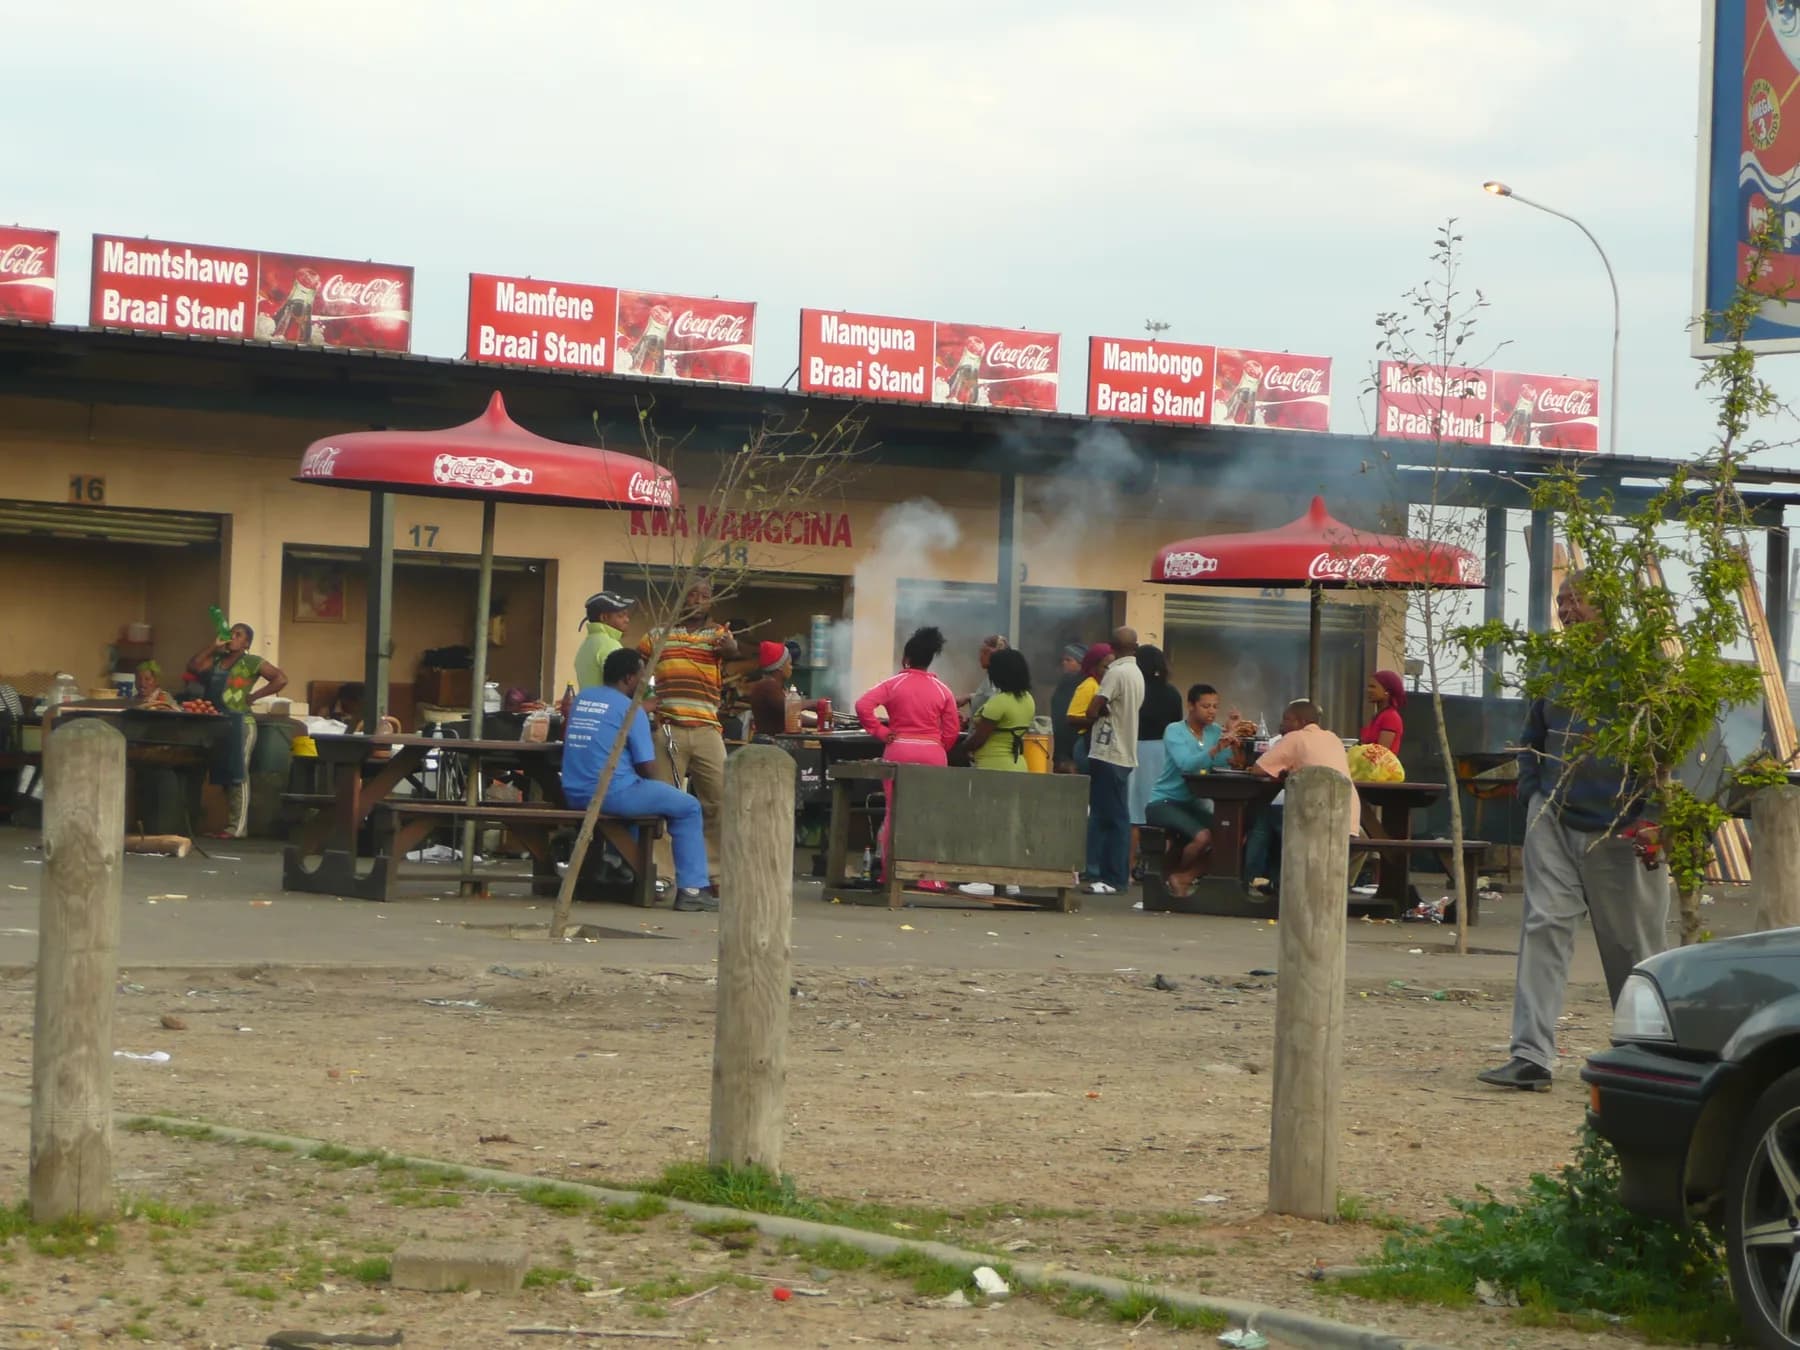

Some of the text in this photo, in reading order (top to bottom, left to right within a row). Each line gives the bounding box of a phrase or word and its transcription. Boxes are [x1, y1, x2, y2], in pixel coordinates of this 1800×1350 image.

[1759, 117, 1767, 141] 3
[103, 240, 249, 286] Mamtshawe
[322, 274, 404, 308] Coca-Cola
[495, 281, 594, 321] Mamfene
[102, 288, 244, 333] Braai Stand
[674, 310, 745, 342] Coca-Cola
[479, 325, 605, 366] Braai Stand
[821, 314, 916, 355] Mamguna
[985, 341, 1053, 371] Coca-Cola
[1103, 342, 1204, 383] Mambongo
[809, 356, 924, 394] Braai Stand
[1264, 365, 1325, 394] Coca-Cola
[1097, 383, 1205, 417] Braai Stand
[1538, 388, 1594, 416] Coca-Cola
[1386, 405, 1485, 439] Braai Stand
[70, 476, 104, 500] 16
[409, 525, 440, 548] 17
[1308, 552, 1391, 580] Coca-Cola
